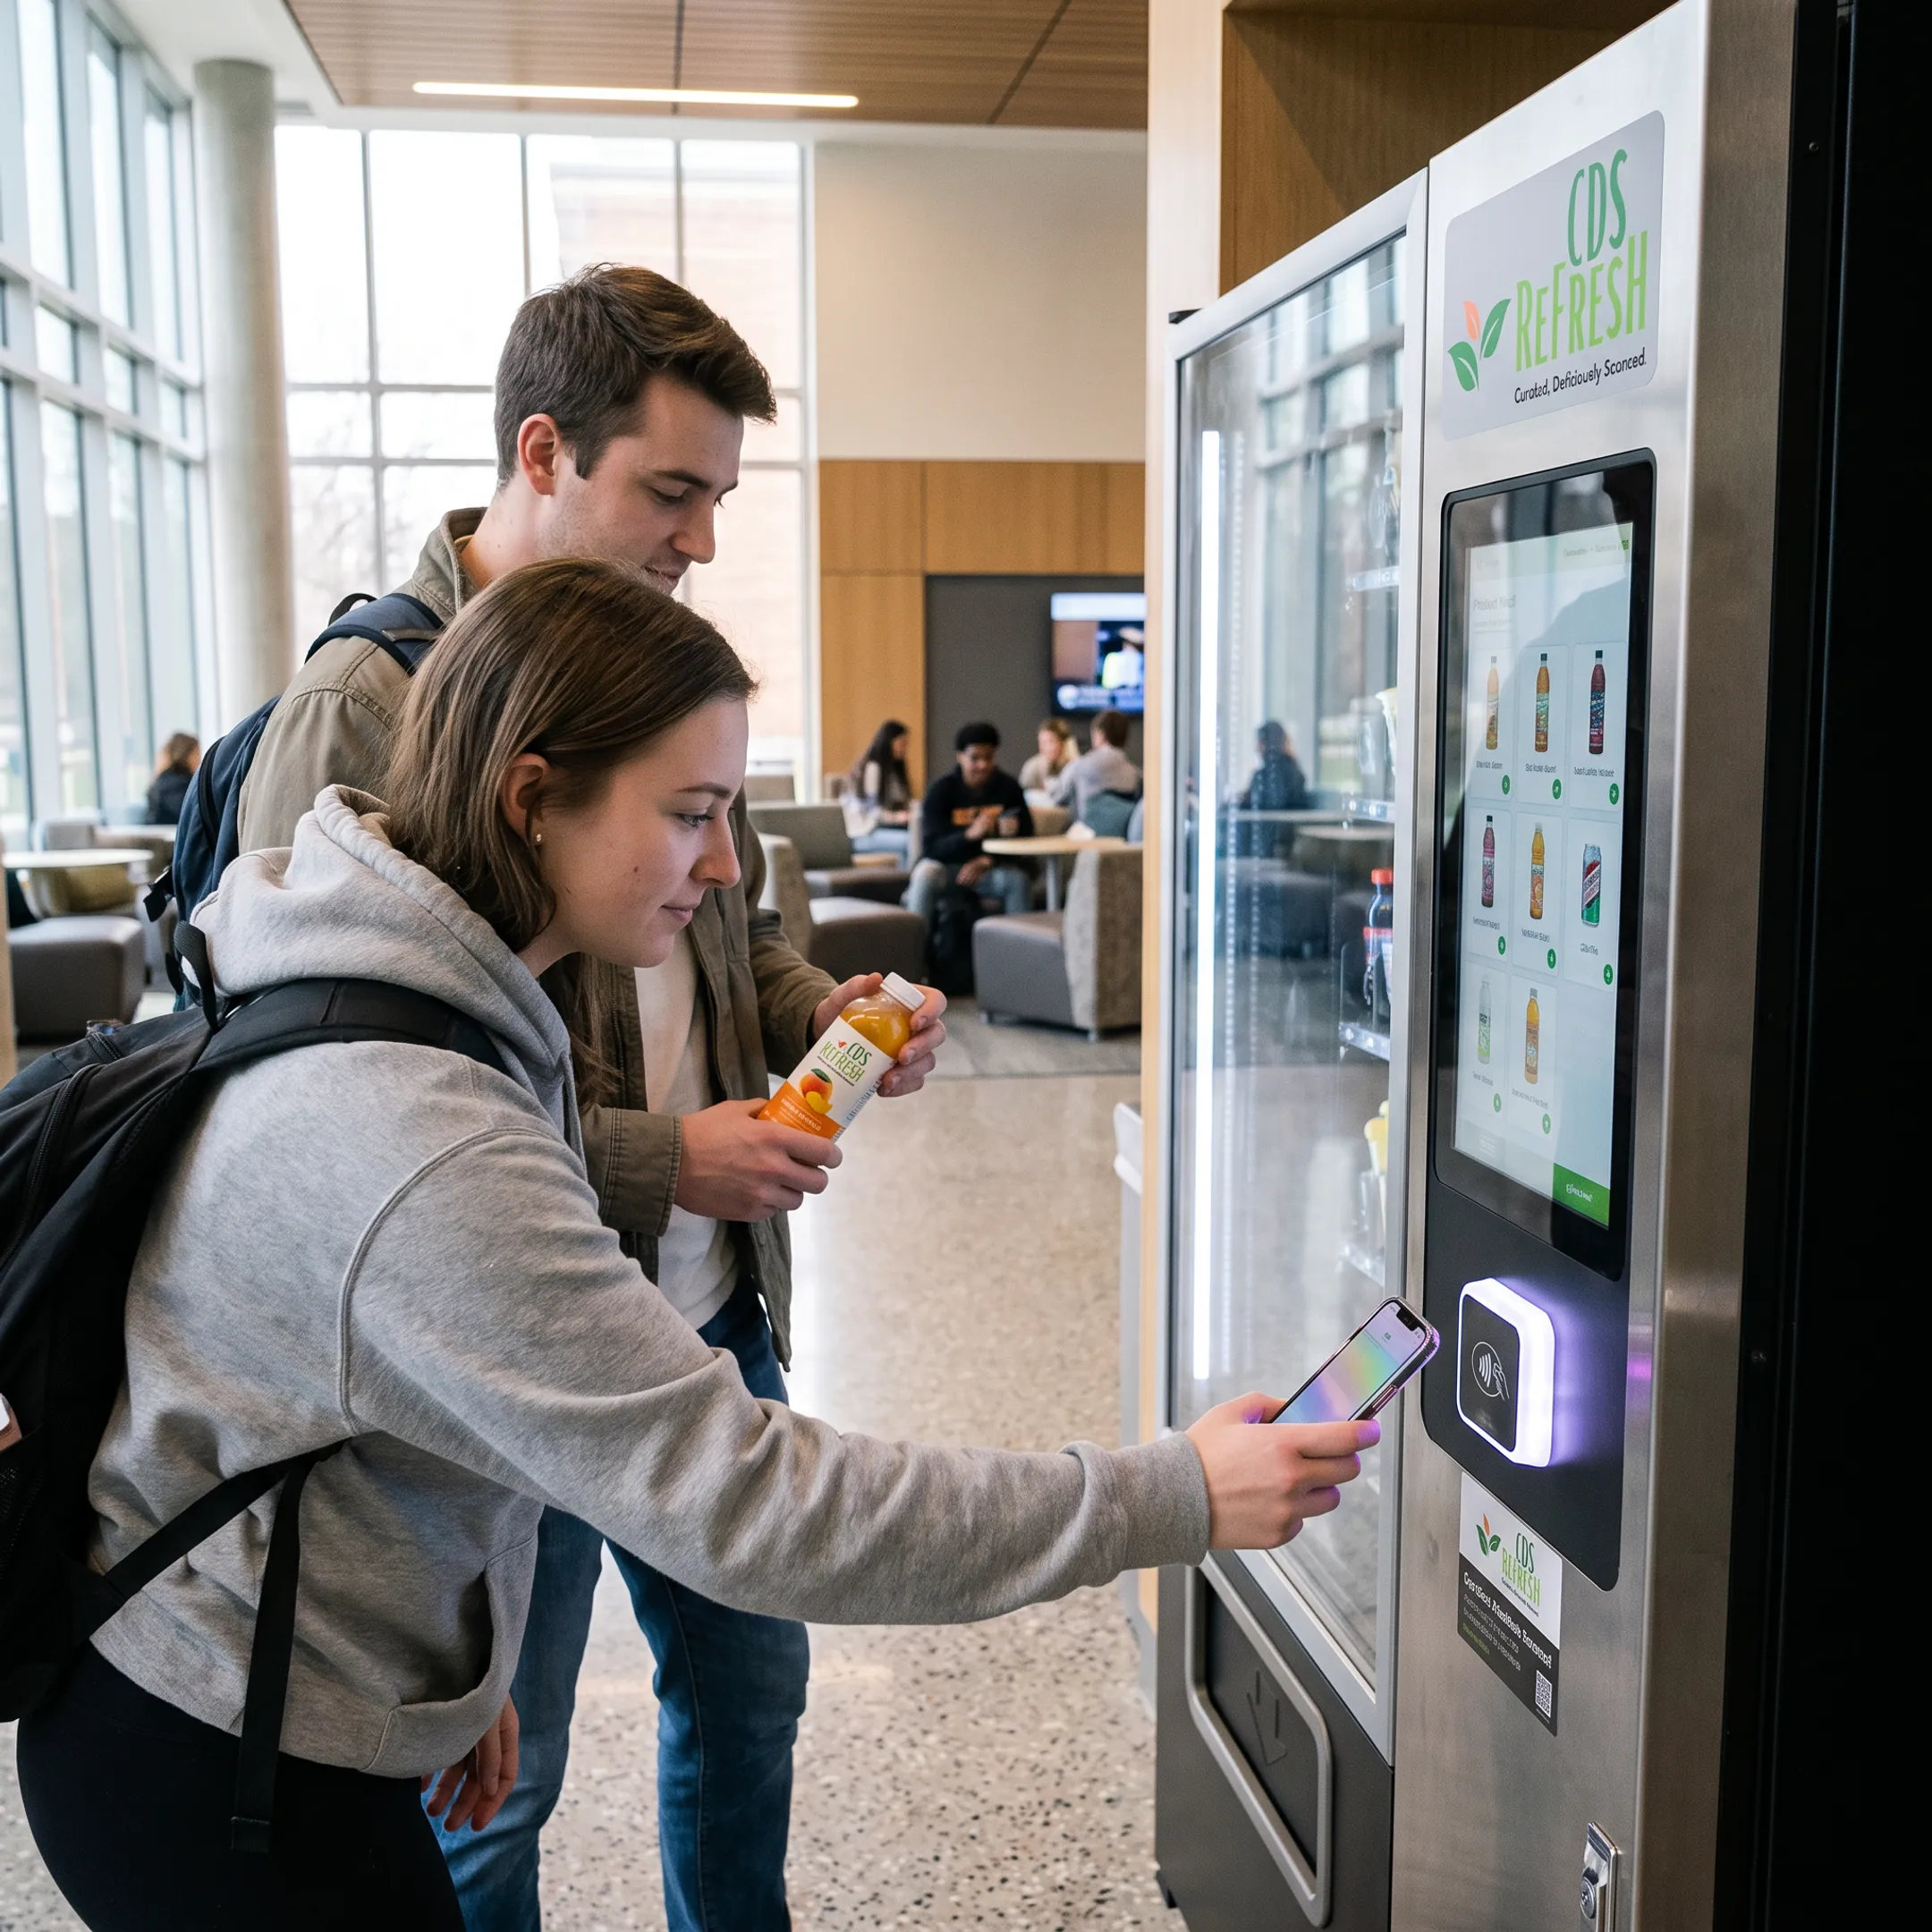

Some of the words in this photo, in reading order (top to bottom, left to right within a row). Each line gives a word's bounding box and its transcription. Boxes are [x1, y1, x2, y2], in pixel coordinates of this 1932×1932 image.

[1567, 148, 1628, 267] CDS
[846, 1042, 872, 1066] CDS
[1502, 1546, 1540, 1607] REFRESH
[1515, 1532, 1535, 1574] CDS
